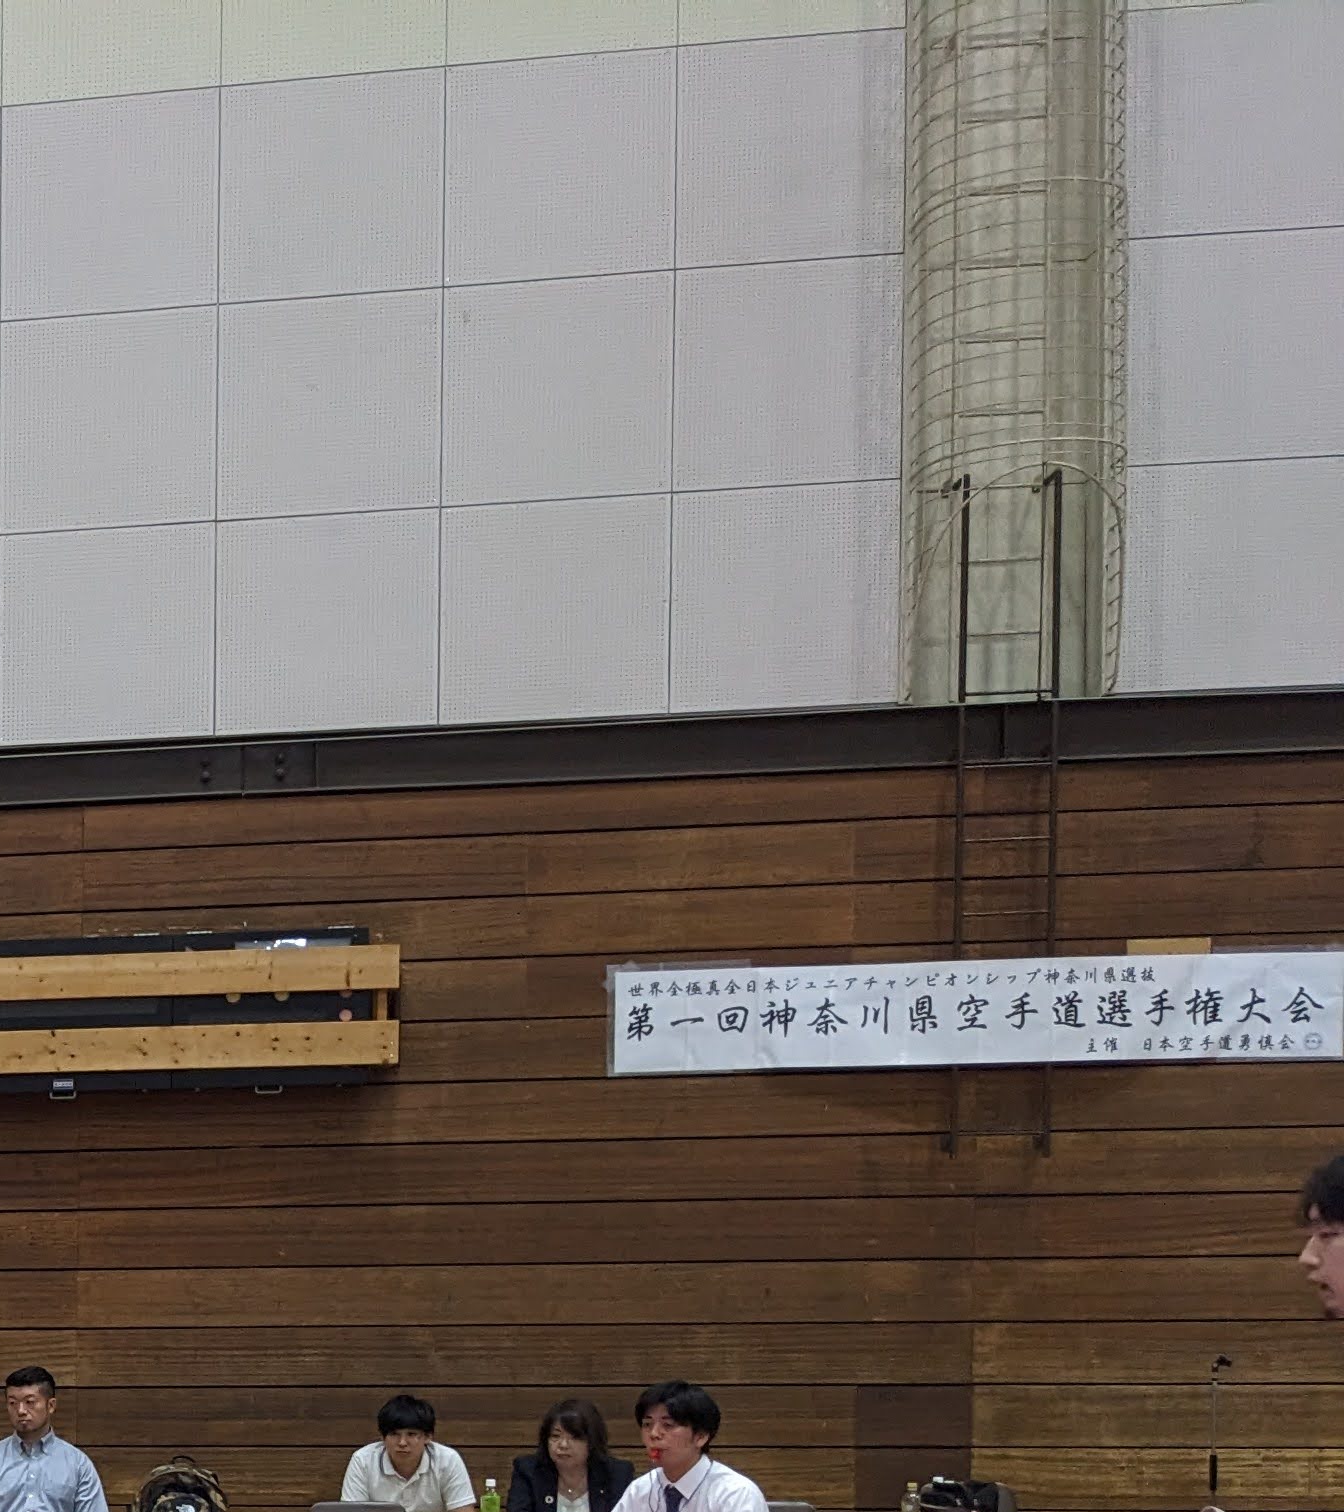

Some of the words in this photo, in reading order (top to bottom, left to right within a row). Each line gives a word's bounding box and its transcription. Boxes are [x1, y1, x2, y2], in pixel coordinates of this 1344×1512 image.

[626, 986, 1325, 1042] 第一回神奈川県空手道選手権大会
